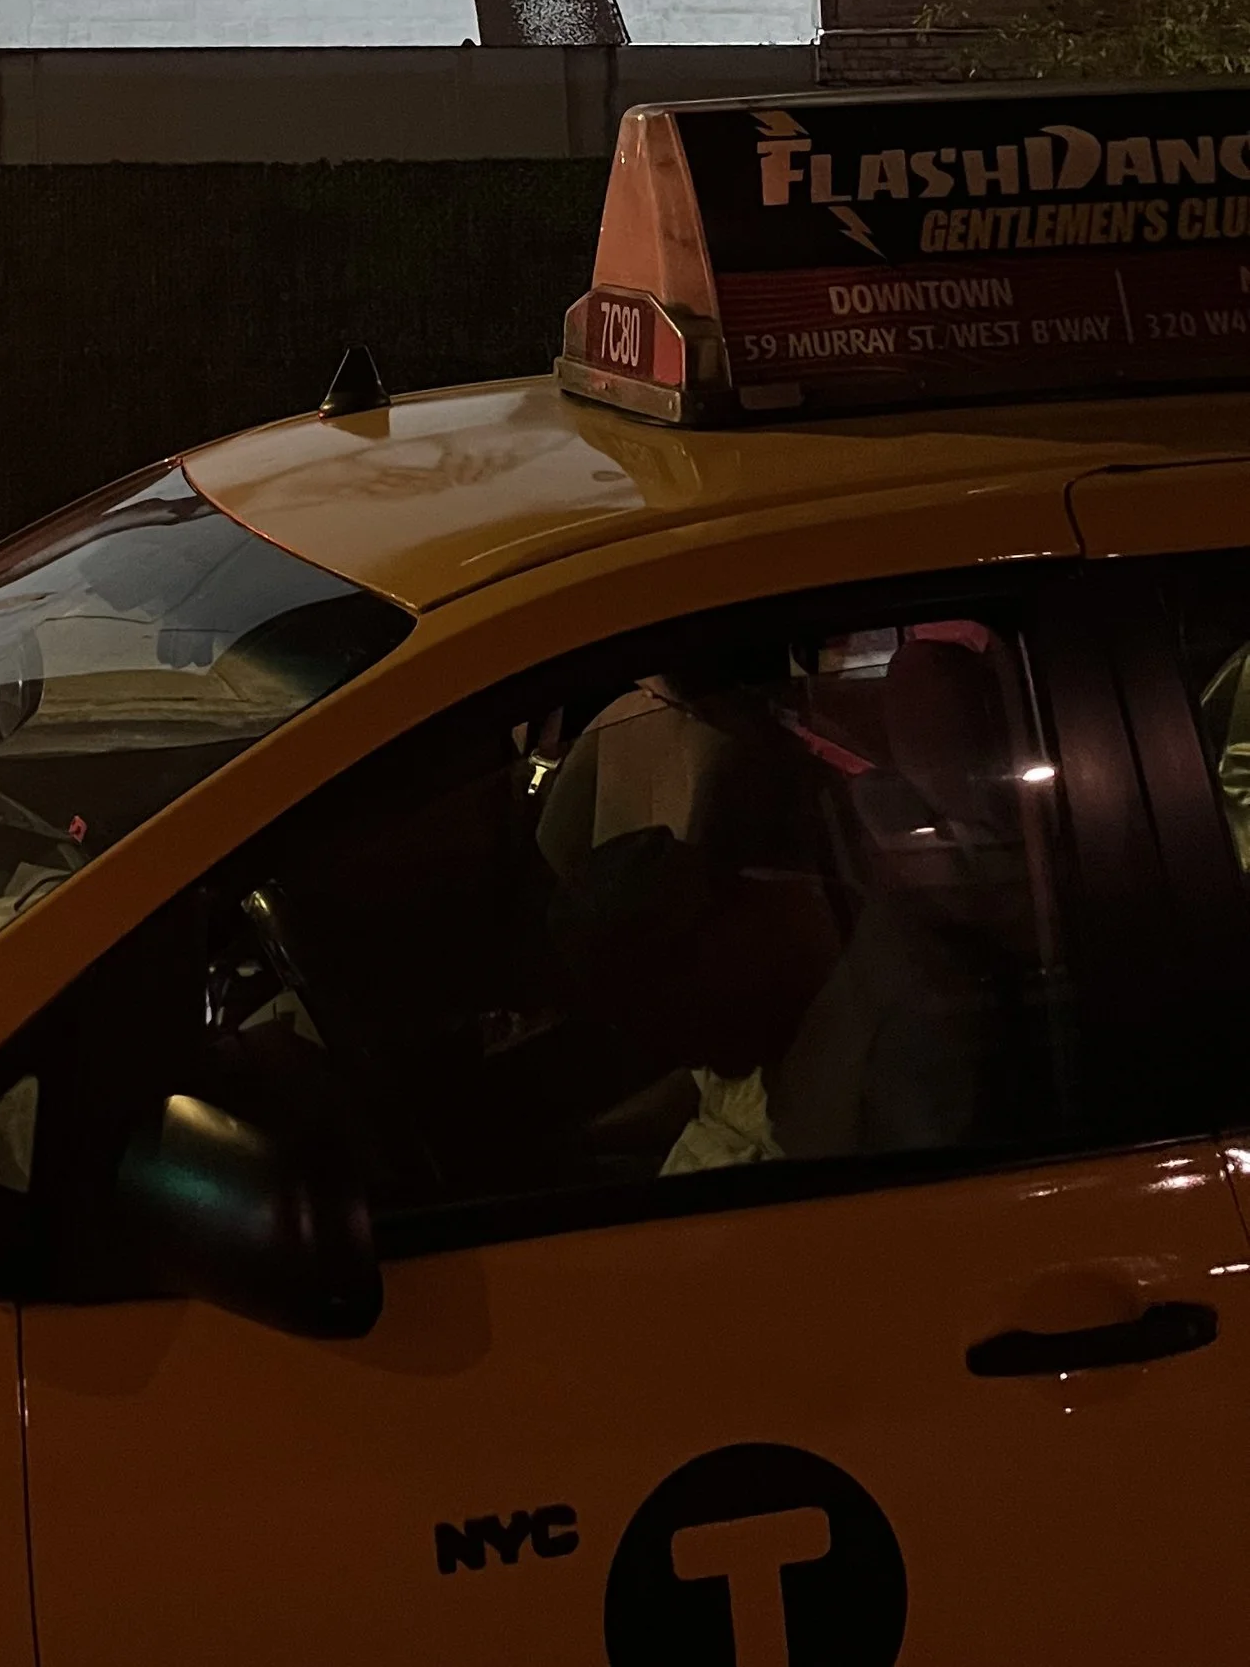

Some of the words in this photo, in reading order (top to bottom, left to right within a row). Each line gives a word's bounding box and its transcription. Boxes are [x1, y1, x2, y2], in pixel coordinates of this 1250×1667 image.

[919, 197, 1170, 254] GENTLEMEN'S
[1177, 194, 1250, 242] CLU
[827, 277, 1015, 316] DOWNTOWN
[600, 301, 641, 367] 7C80
[743, 333, 777, 362] 59
[787, 326, 898, 359] MURRAY
[1144, 310, 1197, 339] 320
[1202, 306, 1250, 336] W4
[434, 1502, 580, 1576] NYC
